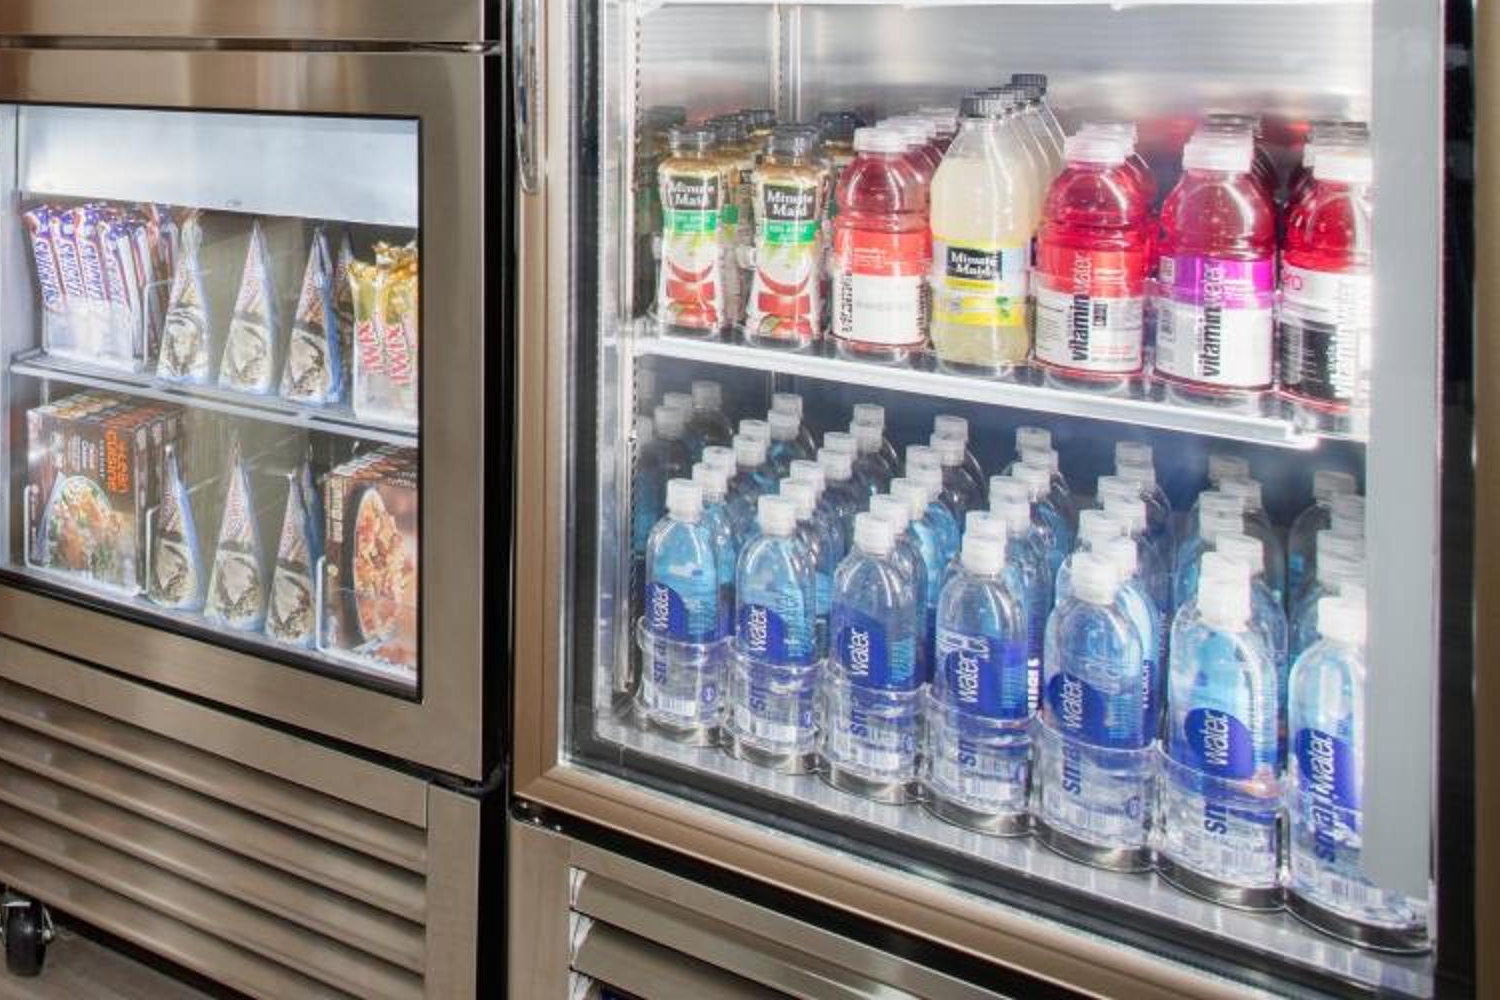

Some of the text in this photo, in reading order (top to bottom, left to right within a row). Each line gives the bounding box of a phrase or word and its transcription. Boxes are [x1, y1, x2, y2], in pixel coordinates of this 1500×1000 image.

[767, 190, 814, 205] Minute
[772, 203, 808, 217] Maid
[950, 250, 997, 267] Minute
[955, 261, 995, 279] Maid
[749, 604, 768, 653] water
[850, 627, 870, 677] water
[956, 654, 980, 703] water
[1062, 674, 1083, 730] water
[1204, 710, 1229, 766] water
